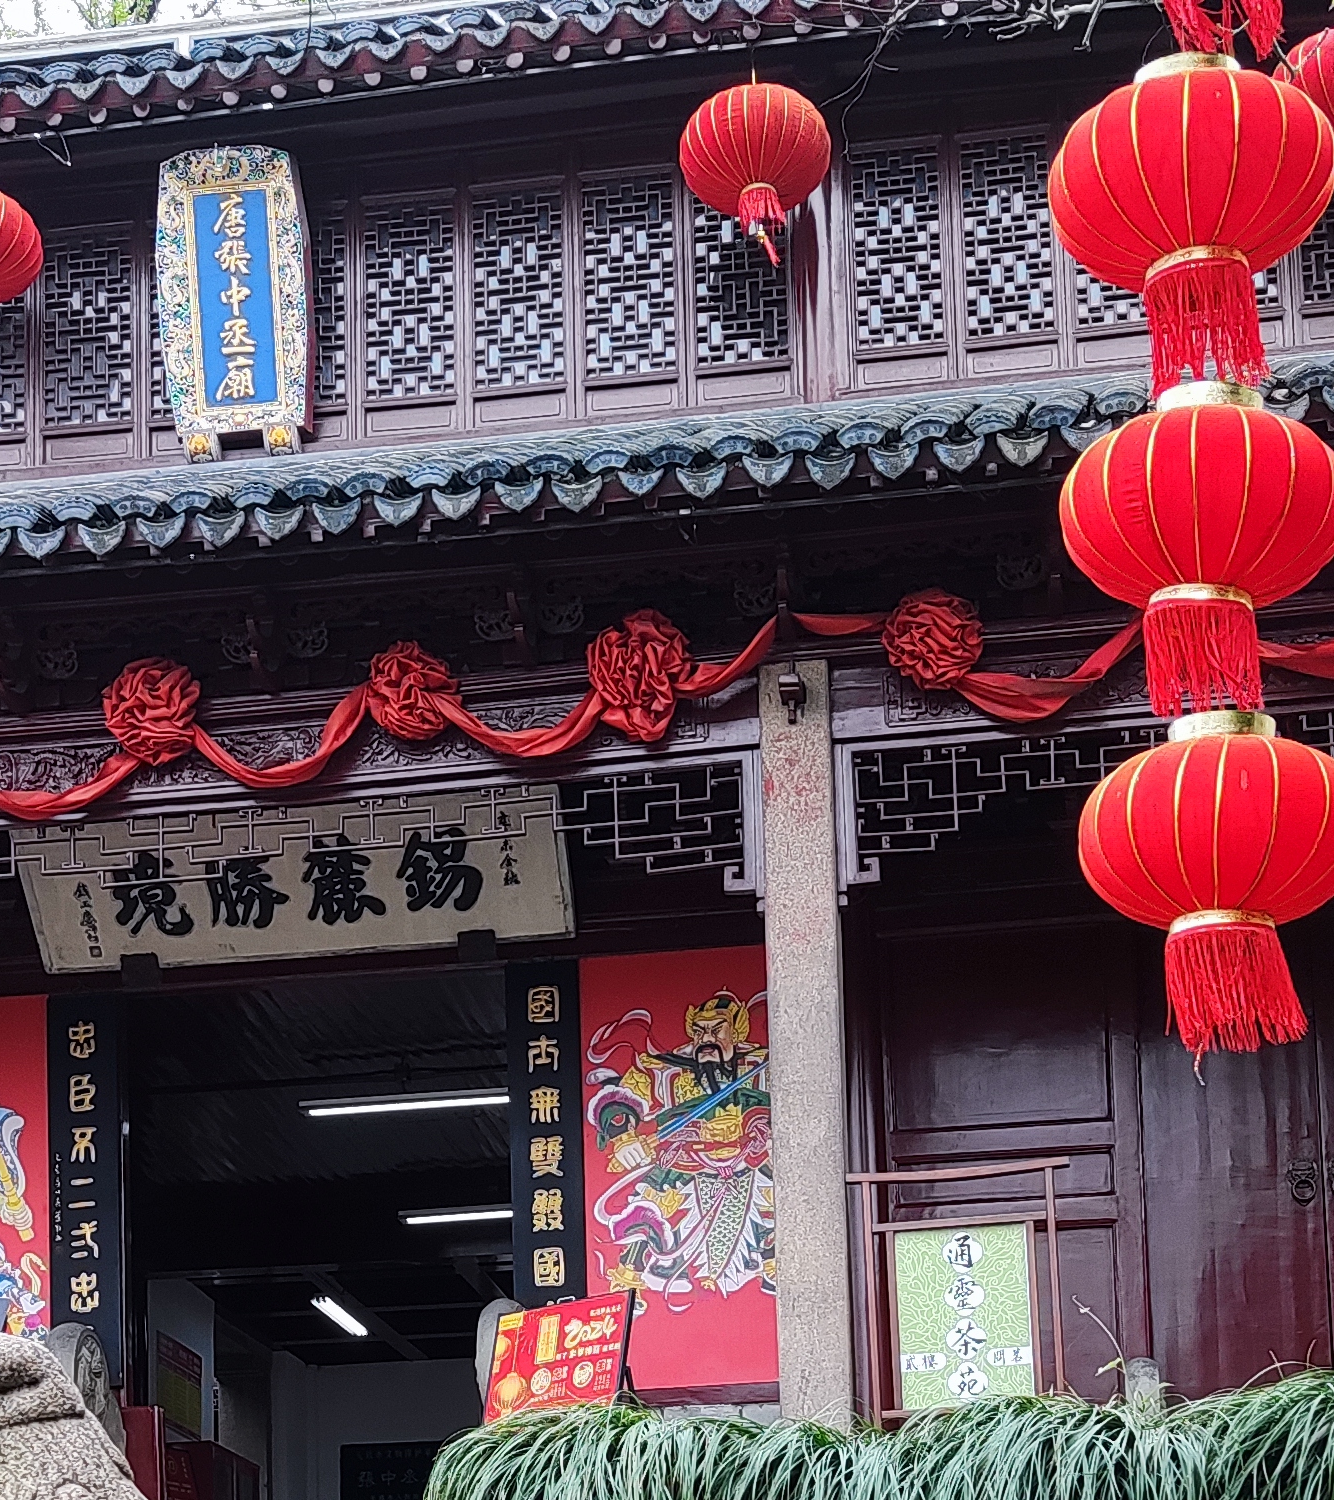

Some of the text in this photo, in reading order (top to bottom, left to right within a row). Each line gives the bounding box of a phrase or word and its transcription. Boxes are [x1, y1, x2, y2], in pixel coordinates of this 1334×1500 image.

[564, 1314, 619, 1349] 2024
[357, 1468, 430, 1488] 張中丞
